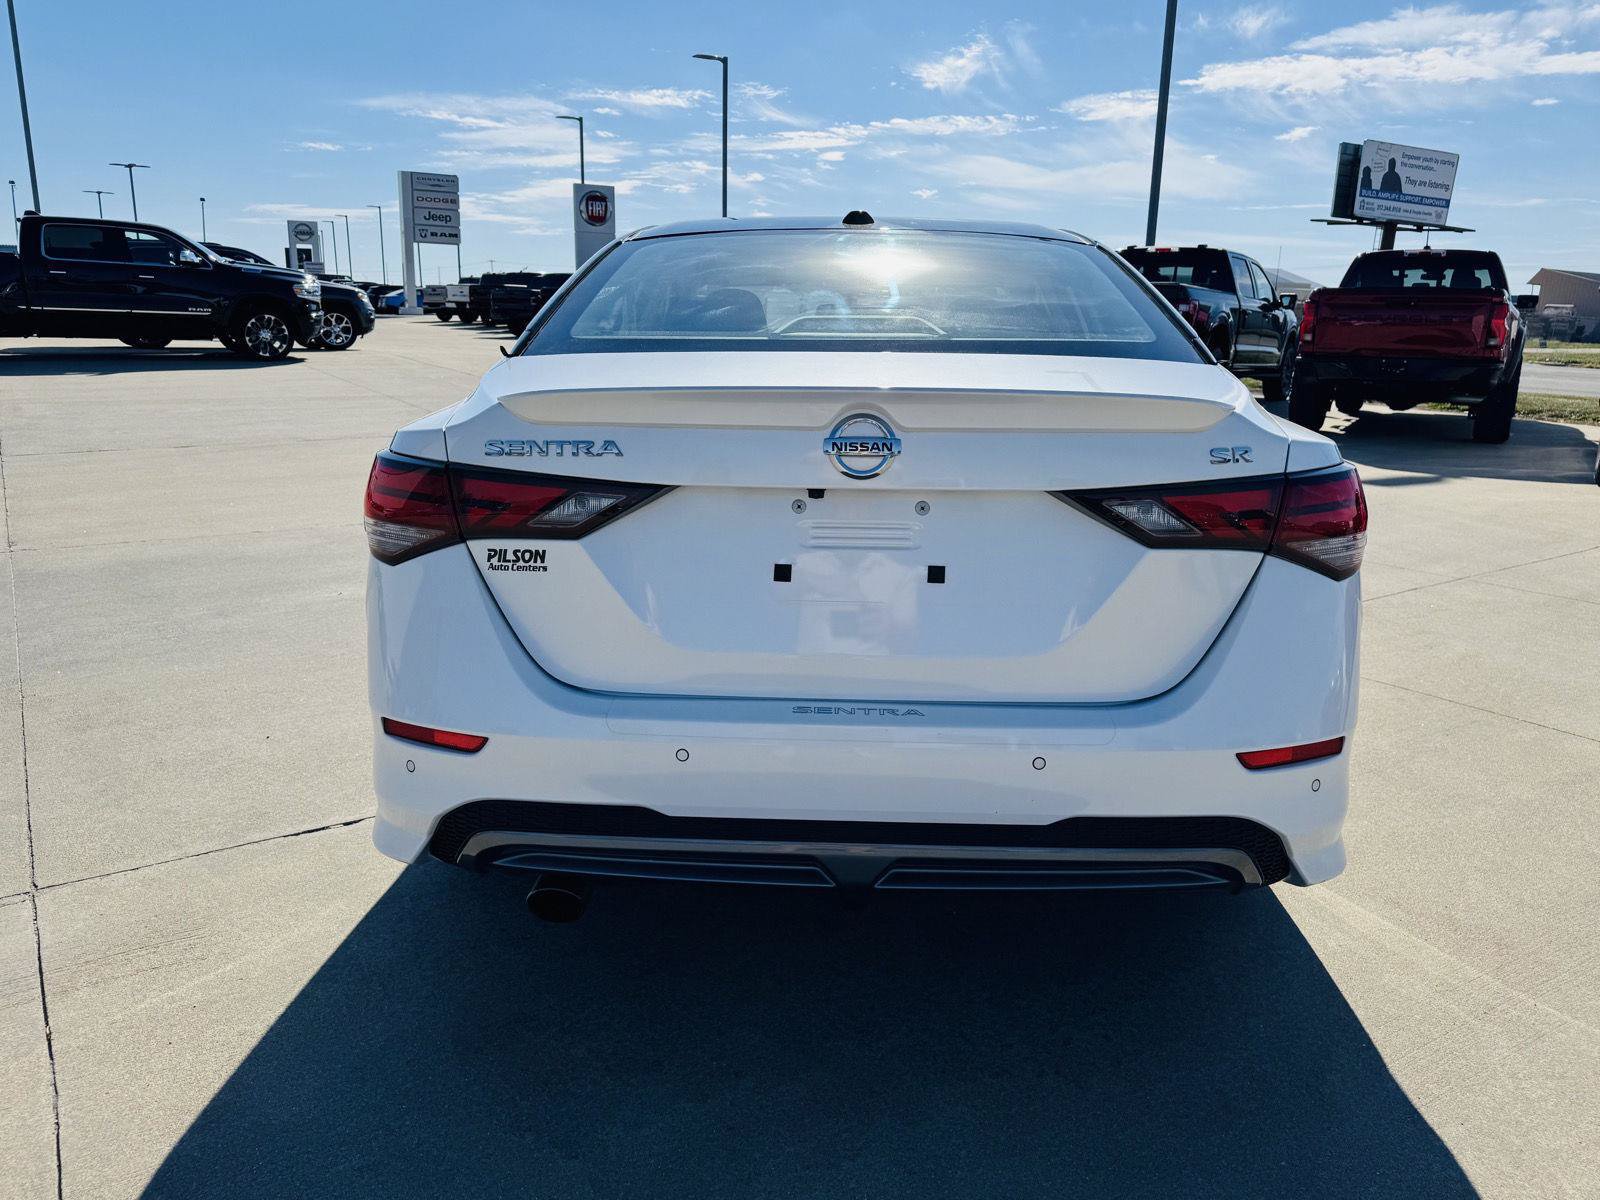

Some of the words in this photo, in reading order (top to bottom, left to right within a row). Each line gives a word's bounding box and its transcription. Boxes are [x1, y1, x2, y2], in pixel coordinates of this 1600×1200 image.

[1402, 151, 1421, 161] Empower
[1440, 159, 1456, 168] starting
[416, 176, 455, 184] CHRYSLER
[1405, 176, 1418, 188] They
[1418, 180, 1427, 188] are
[416, 195, 457, 205] DODGE
[588, 200, 606, 216] FIAT
[423, 211, 452, 224] Jeep
[430, 231, 459, 239] RAM
[484, 439, 624, 457] SENTRA
[831, 441, 893, 452] NISSAN
[1209, 446, 1254, 465] SR
[487, 548, 547, 564] PILSON
[487, 562, 510, 572] Auto
[510, 563, 548, 572] Centers
[791, 705, 926, 717] SENTRA
